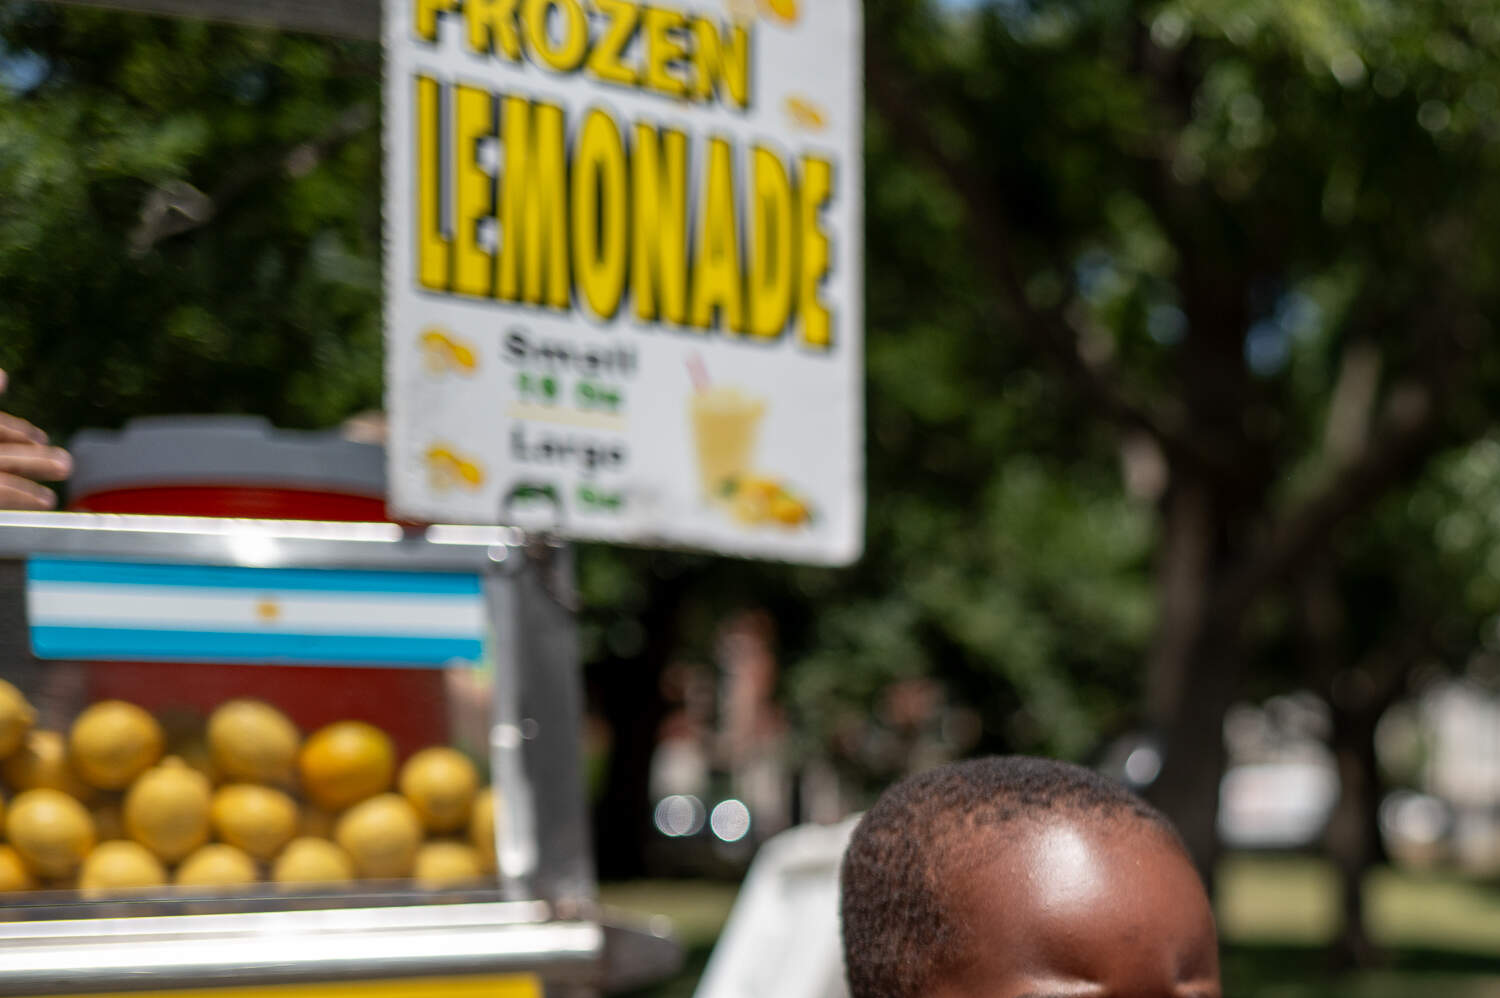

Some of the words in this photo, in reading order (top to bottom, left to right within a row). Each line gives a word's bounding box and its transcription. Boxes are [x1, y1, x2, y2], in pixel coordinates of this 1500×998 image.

[415, 73, 836, 354] LEMONADE
[502, 328, 636, 374] Small
[511, 426, 626, 472] Large
